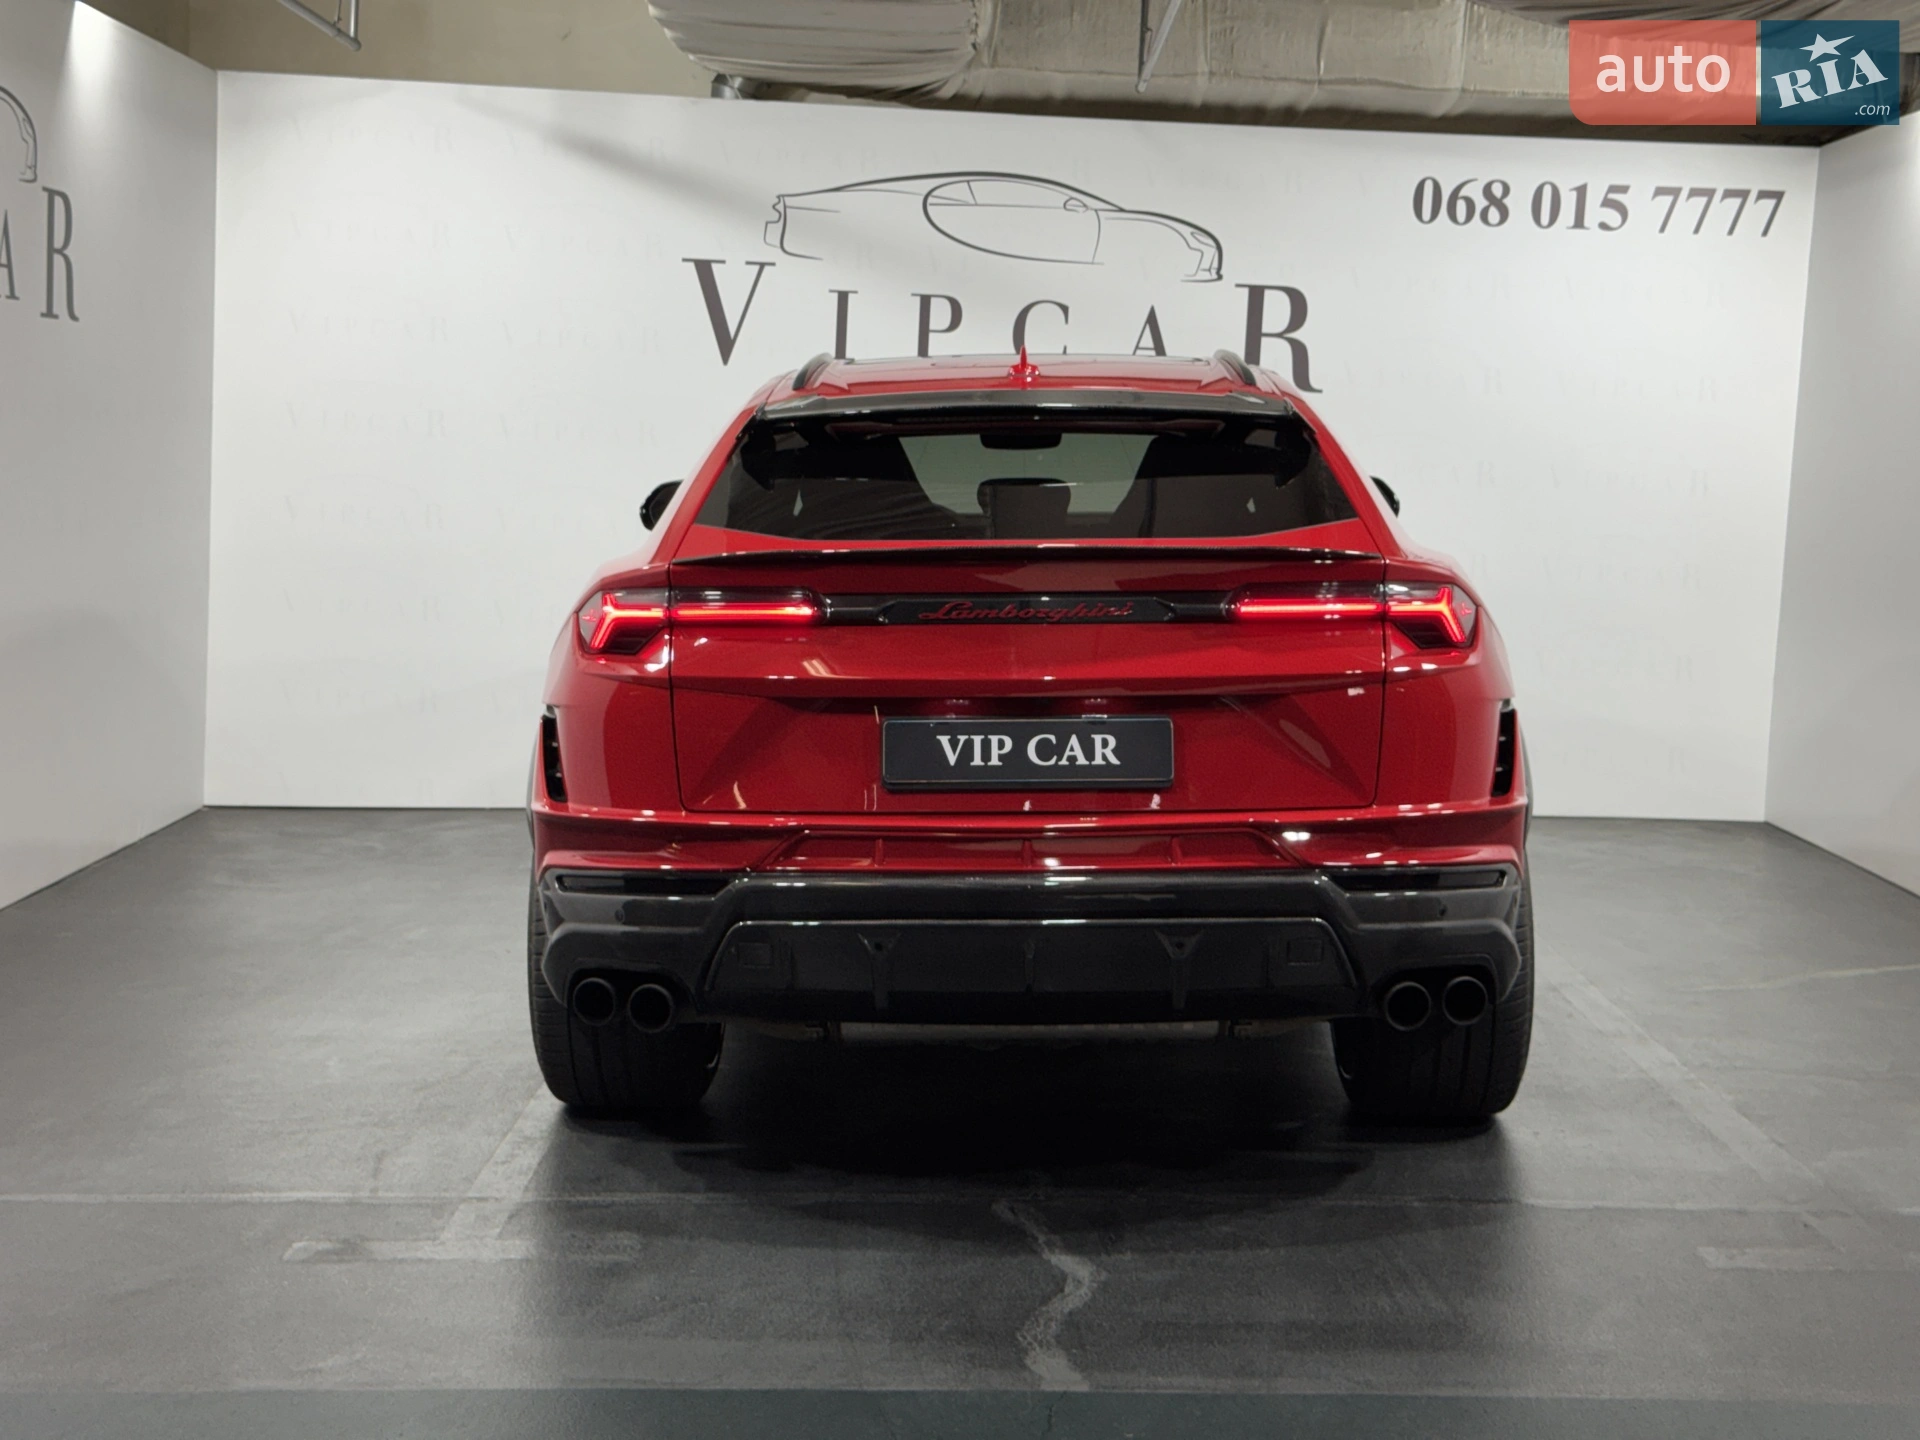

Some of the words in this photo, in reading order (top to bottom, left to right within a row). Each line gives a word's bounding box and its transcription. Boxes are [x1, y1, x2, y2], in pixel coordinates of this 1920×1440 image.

[1412, 176, 1511, 228] 068
[1530, 181, 1630, 232] 015
[1652, 186, 1786, 238] 7777
[918, 601, 1134, 622] Lamborghini
[936, 734, 1013, 767] VIP
[1026, 733, 1121, 767] CAR
